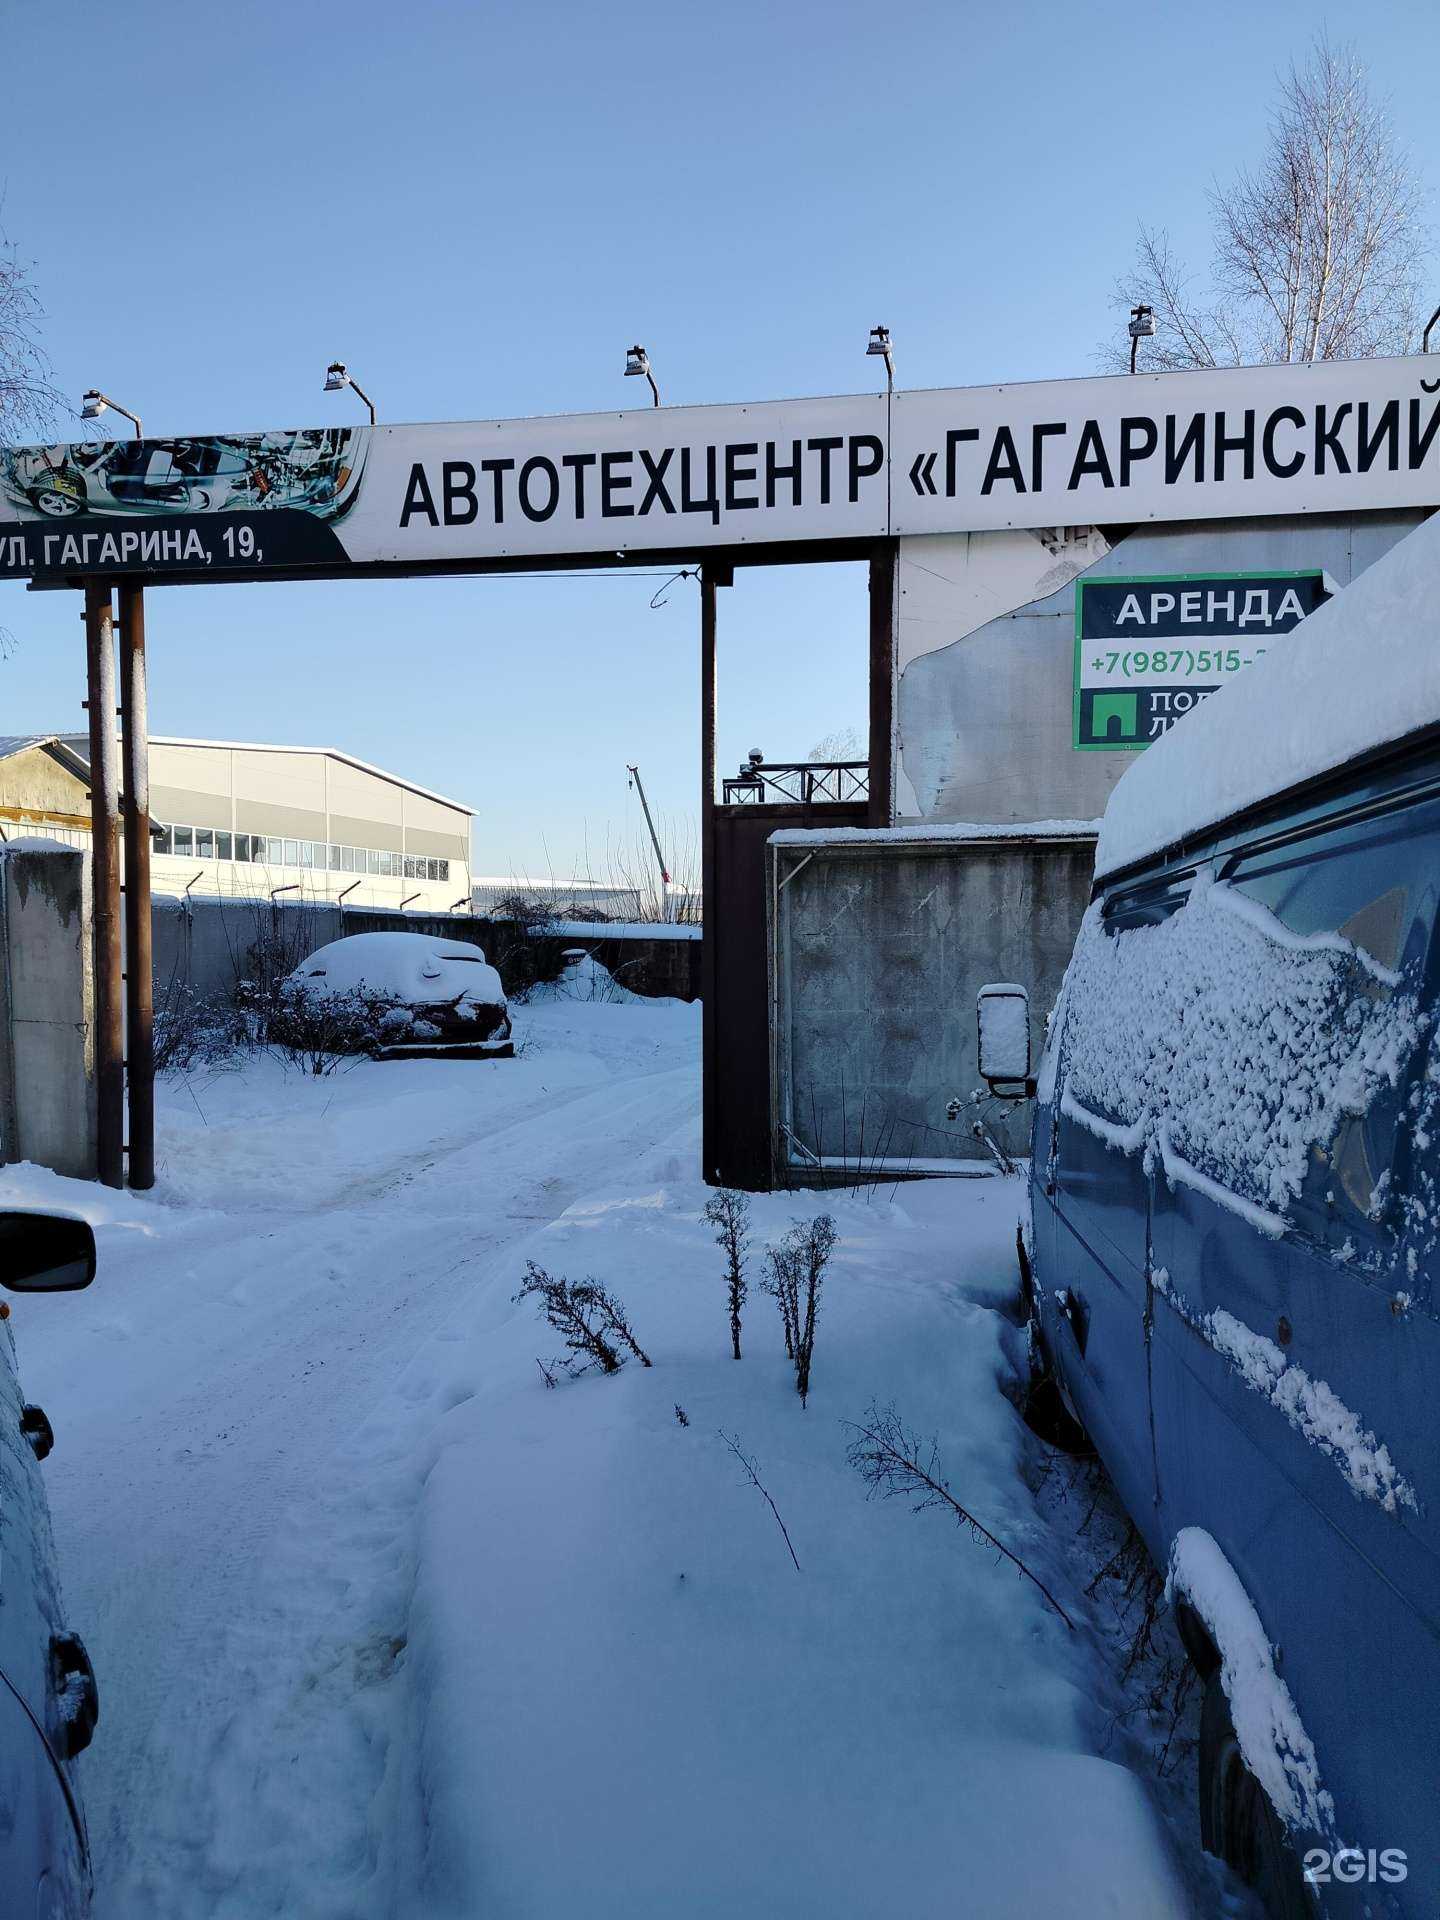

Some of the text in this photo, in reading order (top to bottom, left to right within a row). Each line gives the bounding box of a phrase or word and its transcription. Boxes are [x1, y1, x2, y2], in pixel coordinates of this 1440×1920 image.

[399, 434, 884, 527] АВТОТЕХЦЕНТР
[44, 528, 212, 565] ГАГАРИНА,
[222, 525, 263, 563] 19,
[1115, 588, 1306, 628] АРЕНДА
[1091, 648, 1267, 678] +7(987)515-
